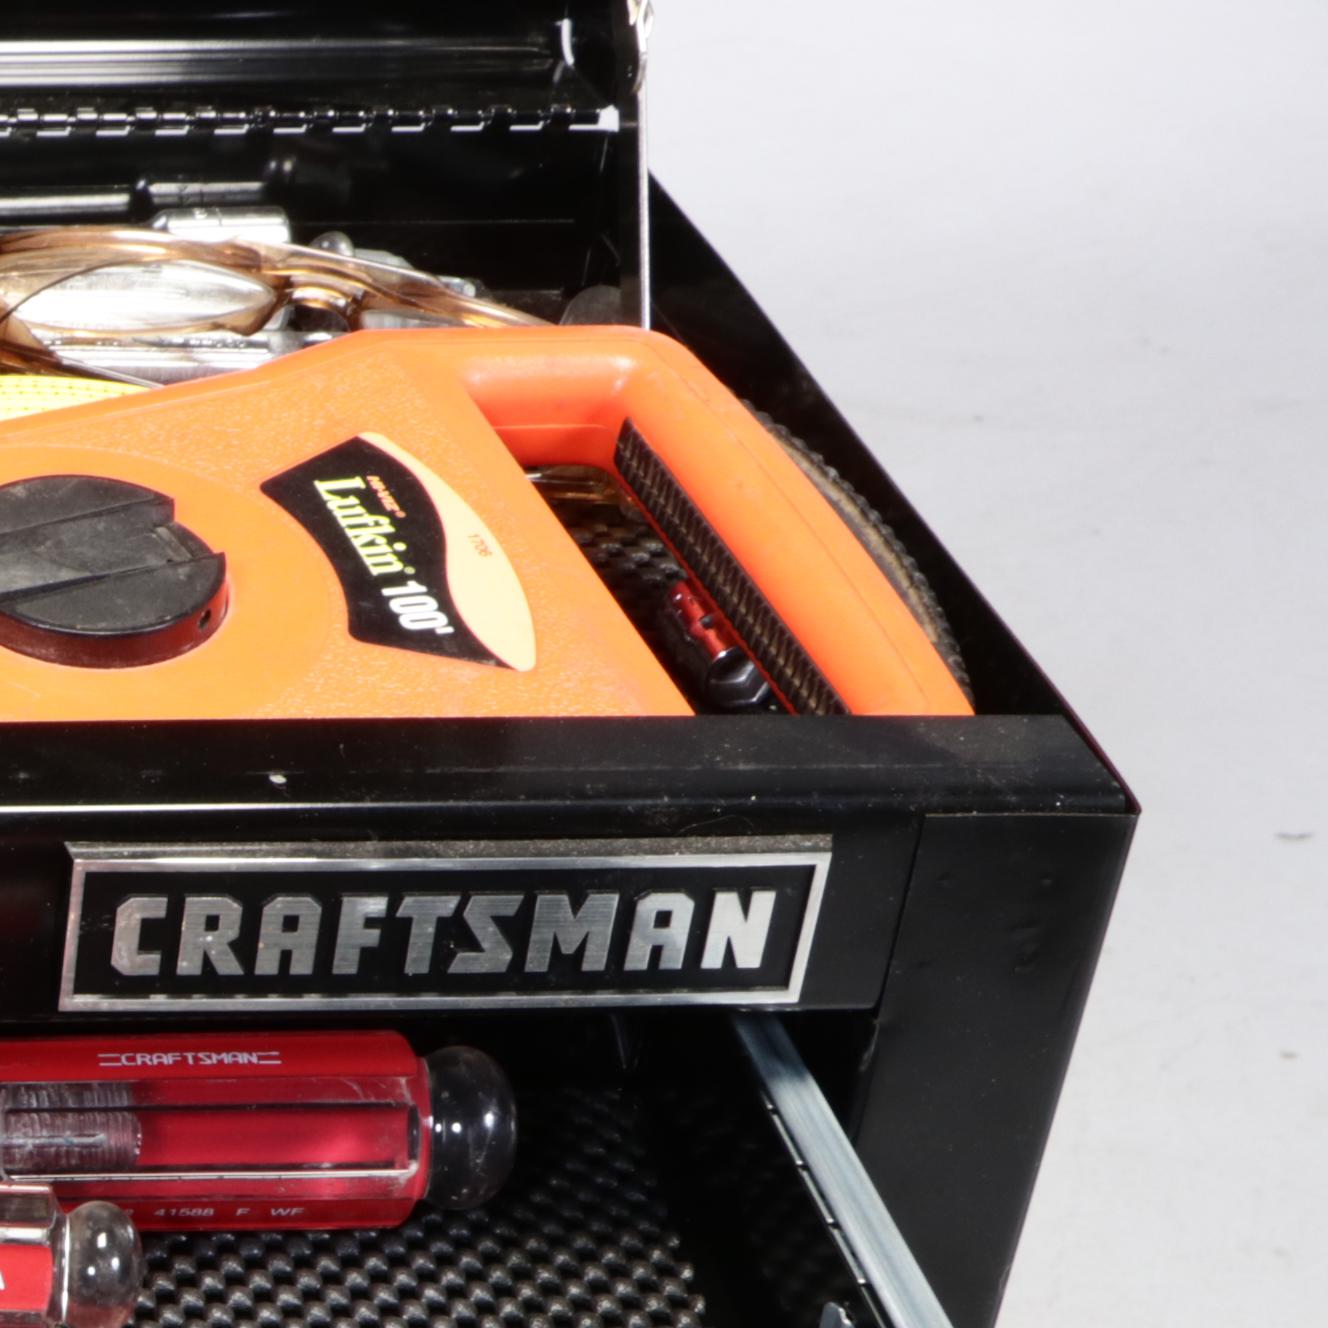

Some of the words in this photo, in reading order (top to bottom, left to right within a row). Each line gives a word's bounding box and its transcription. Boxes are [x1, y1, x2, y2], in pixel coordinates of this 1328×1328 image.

[313, 475, 404, 577] Lufkin
[110, 888, 778, 977] CRAFTSMAN
[121, 1050, 259, 1067] CRAFTSMAN
